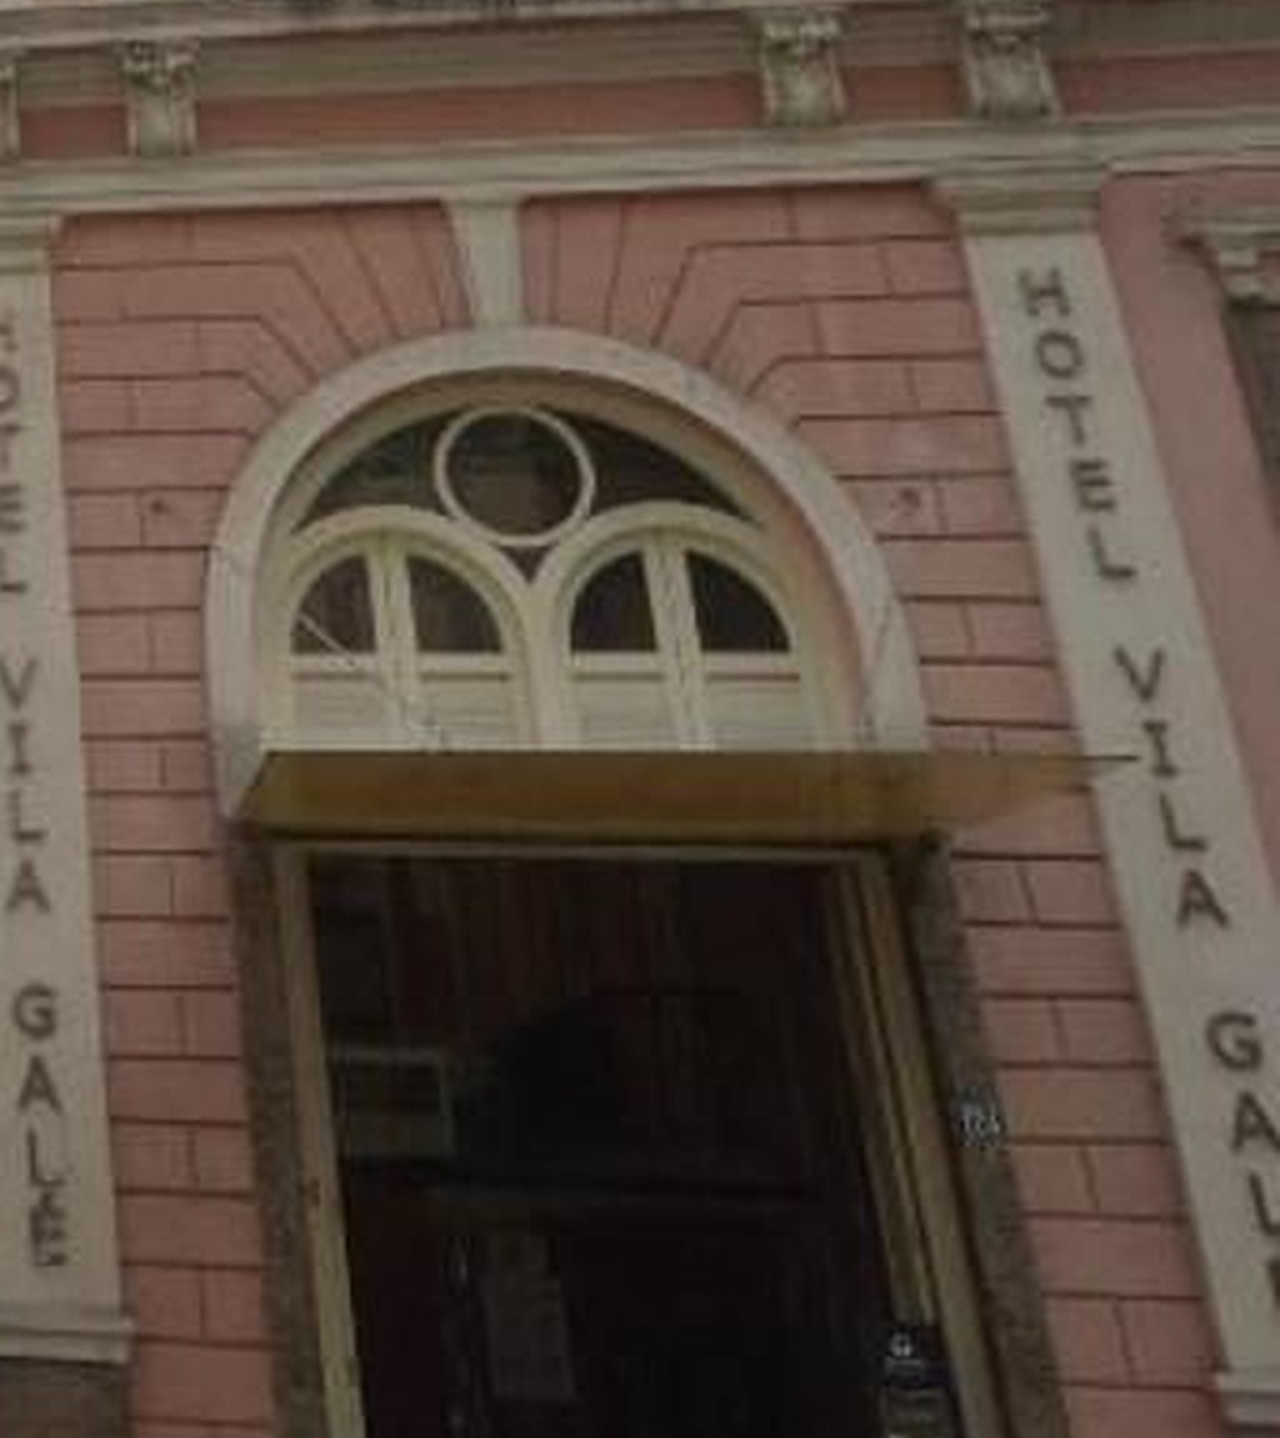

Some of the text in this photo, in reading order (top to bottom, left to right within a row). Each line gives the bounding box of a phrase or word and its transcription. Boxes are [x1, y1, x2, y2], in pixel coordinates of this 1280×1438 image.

[1017, 265, 1139, 582] HOTEL
[1113, 645, 1229, 927] VILA
[11, 981, 69, 1268] GALÉ
